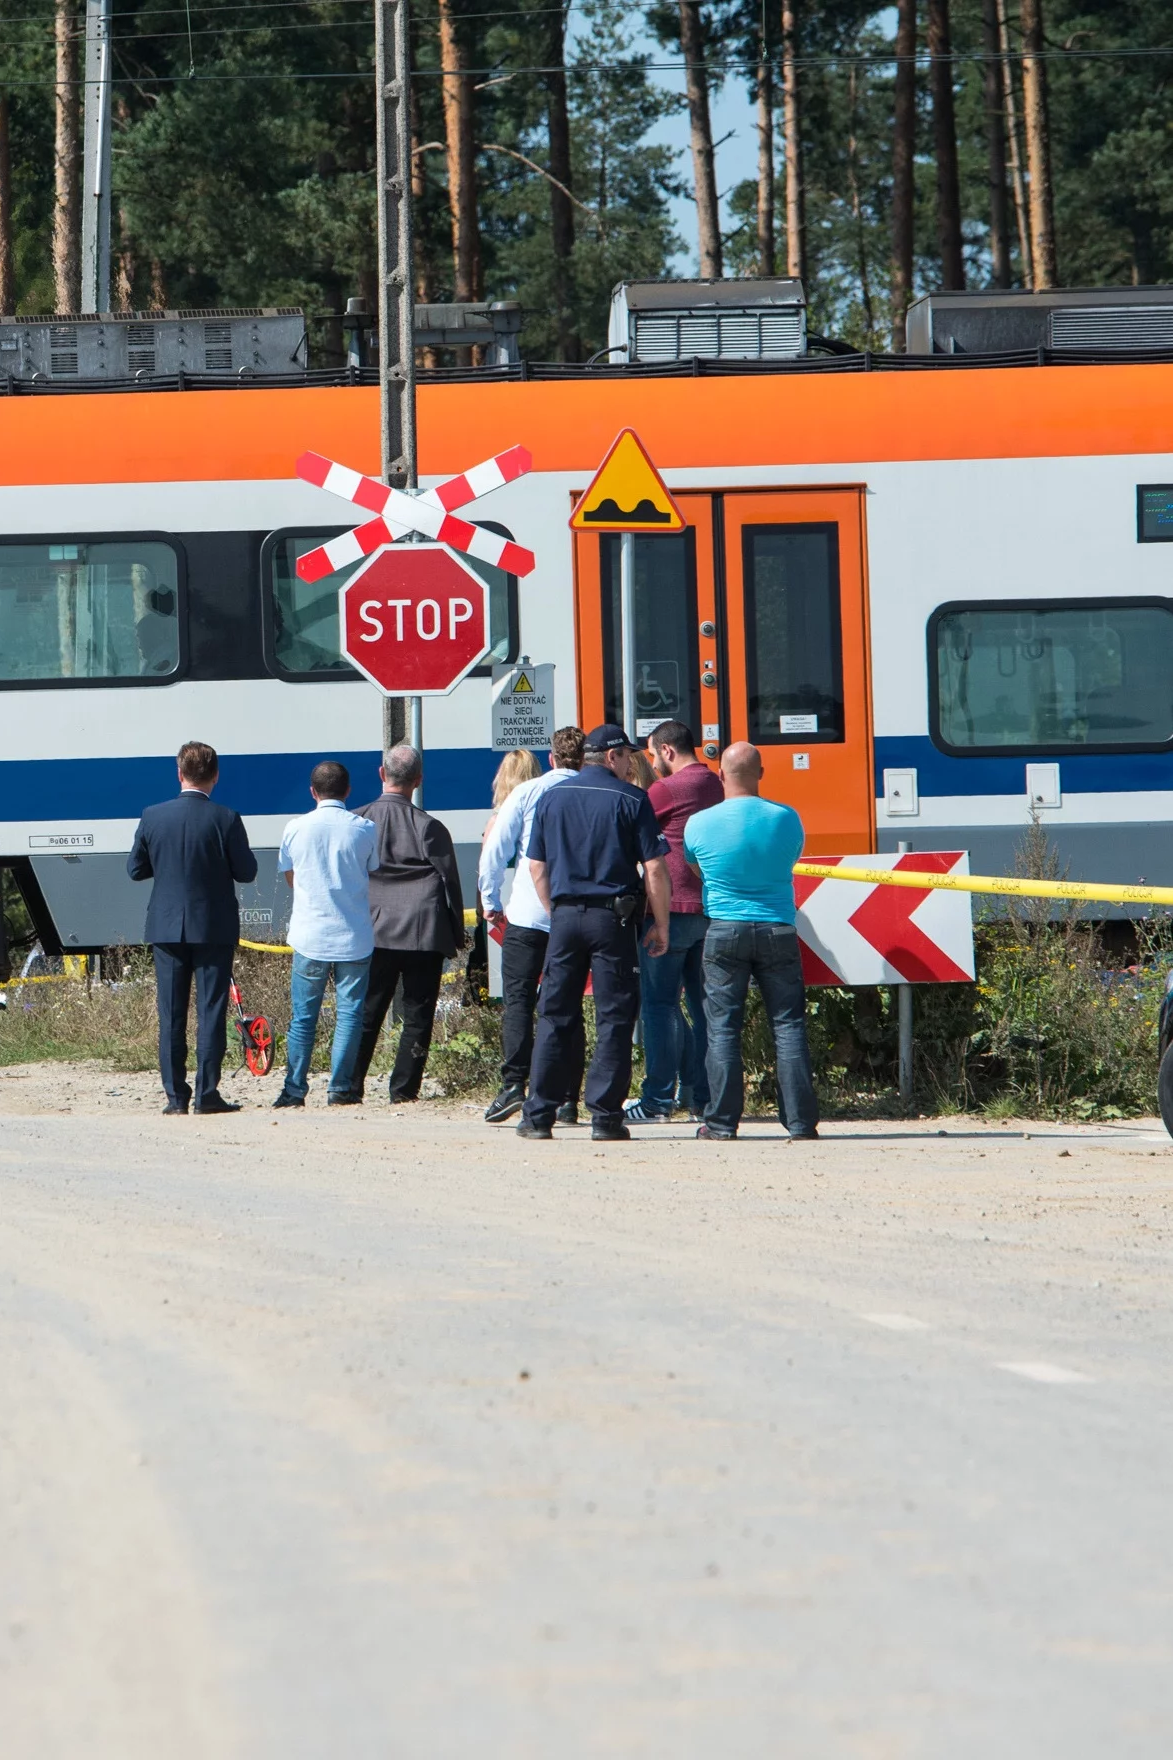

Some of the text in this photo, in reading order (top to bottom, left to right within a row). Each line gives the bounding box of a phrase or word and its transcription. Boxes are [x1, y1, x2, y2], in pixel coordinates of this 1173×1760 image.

[359, 598, 473, 642] STOP
[500, 694, 546, 705] NIE DOTYKAĆ
[514, 707, 532, 715] SIECI
[500, 717, 544, 725] TRAKCYJNEJ
[503, 727, 545, 737] DOTKNIĘCIE
[495, 738, 518, 746] GROZI
